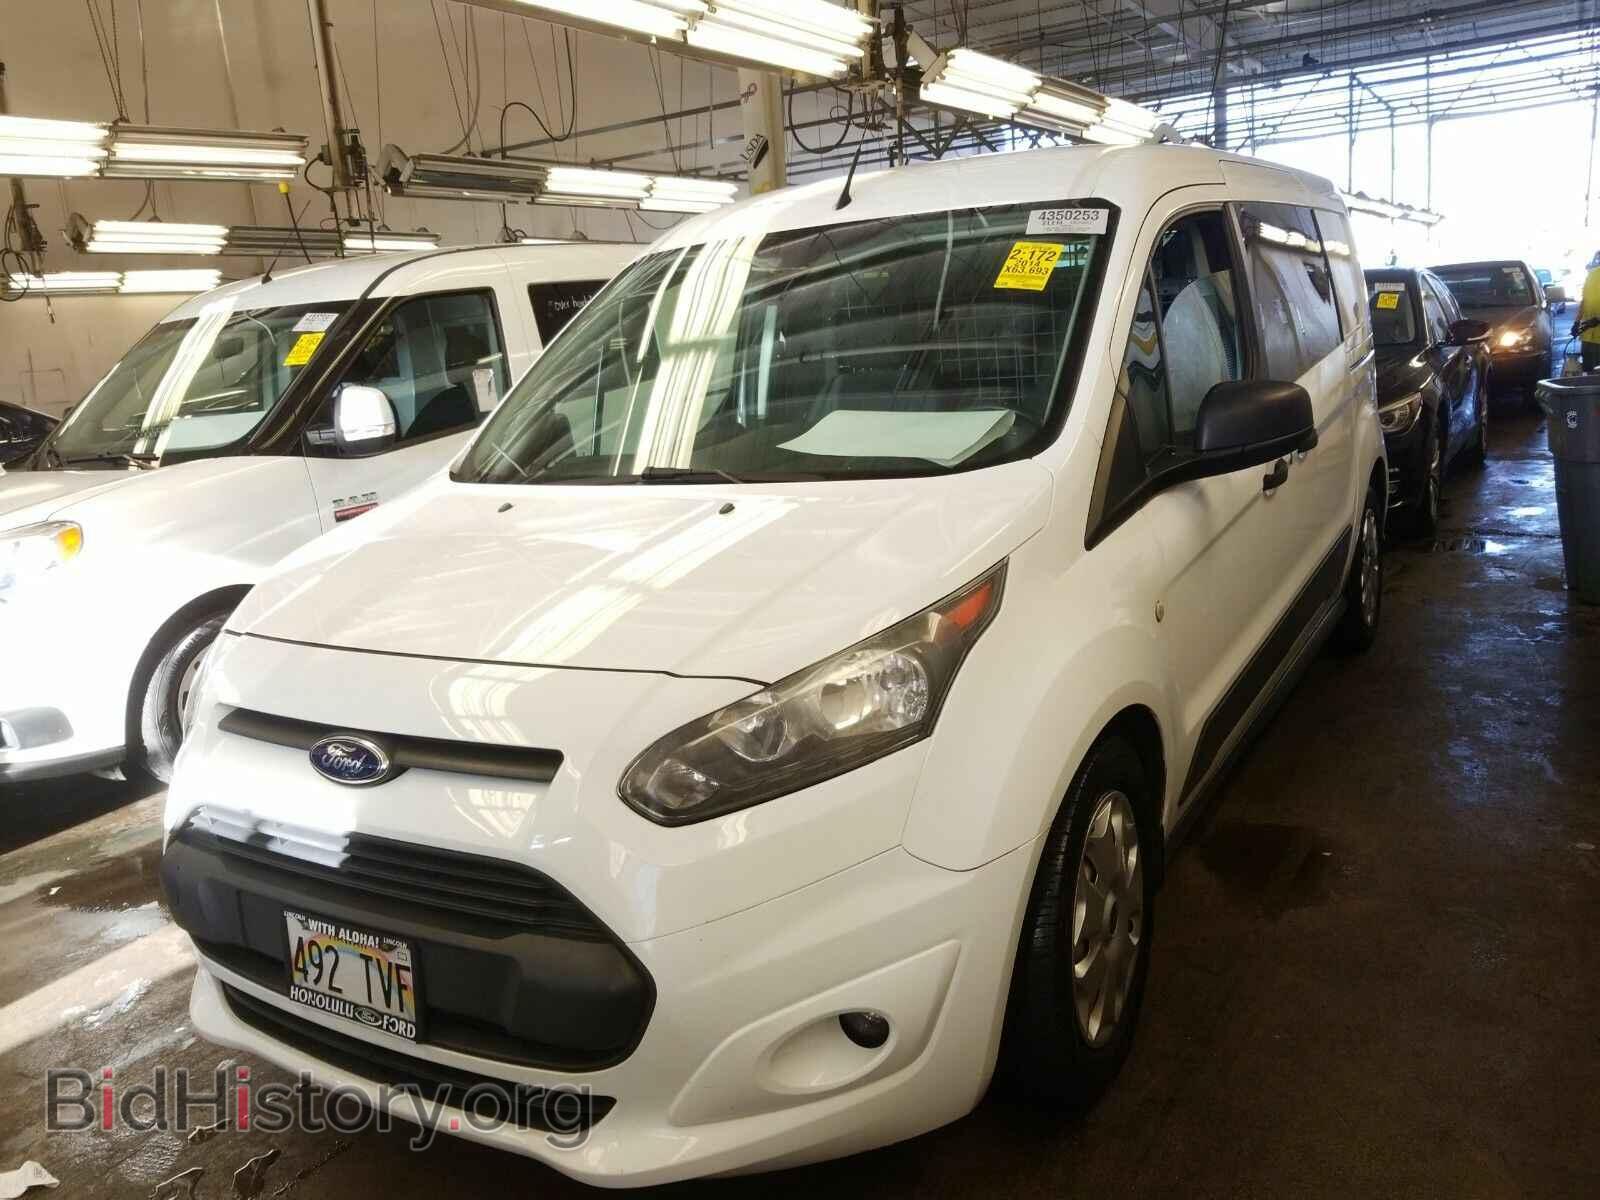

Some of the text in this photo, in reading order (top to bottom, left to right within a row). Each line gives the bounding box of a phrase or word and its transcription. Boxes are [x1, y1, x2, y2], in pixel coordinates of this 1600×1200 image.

[740, 134, 764, 161] USDA
[1038, 210, 1100, 221] 4350253
[321, 743, 368, 772] Ford
[308, 918, 379, 949] WITH ALOHA!
[294, 936, 411, 1013] 492 TVF
[290, 985, 355, 1019] HONOLULU
[382, 1014, 417, 1039] FORD
